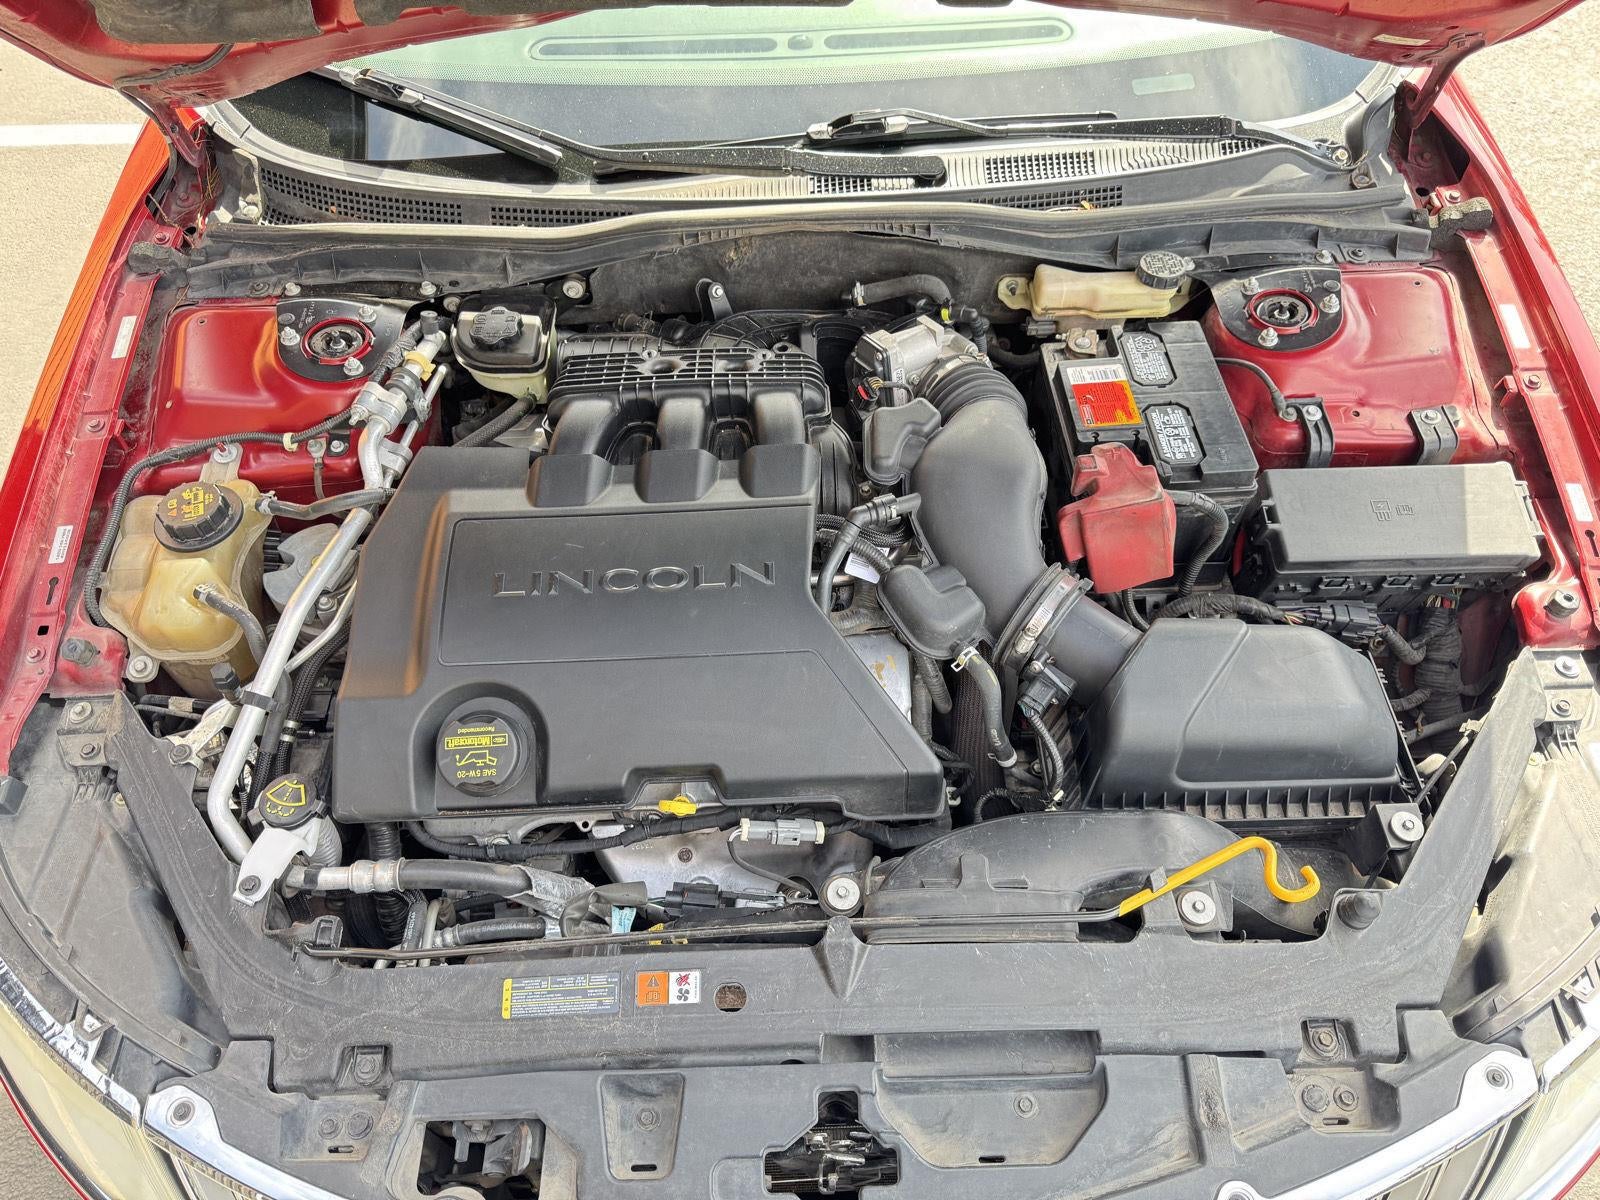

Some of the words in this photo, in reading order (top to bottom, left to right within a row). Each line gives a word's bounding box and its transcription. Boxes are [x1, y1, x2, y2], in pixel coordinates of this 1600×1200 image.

[492, 561, 776, 597] LINCOLN
[457, 726, 495, 734] Recommended
[457, 769, 481, 779] 5W-20
[482, 768, 497, 777] SAE
